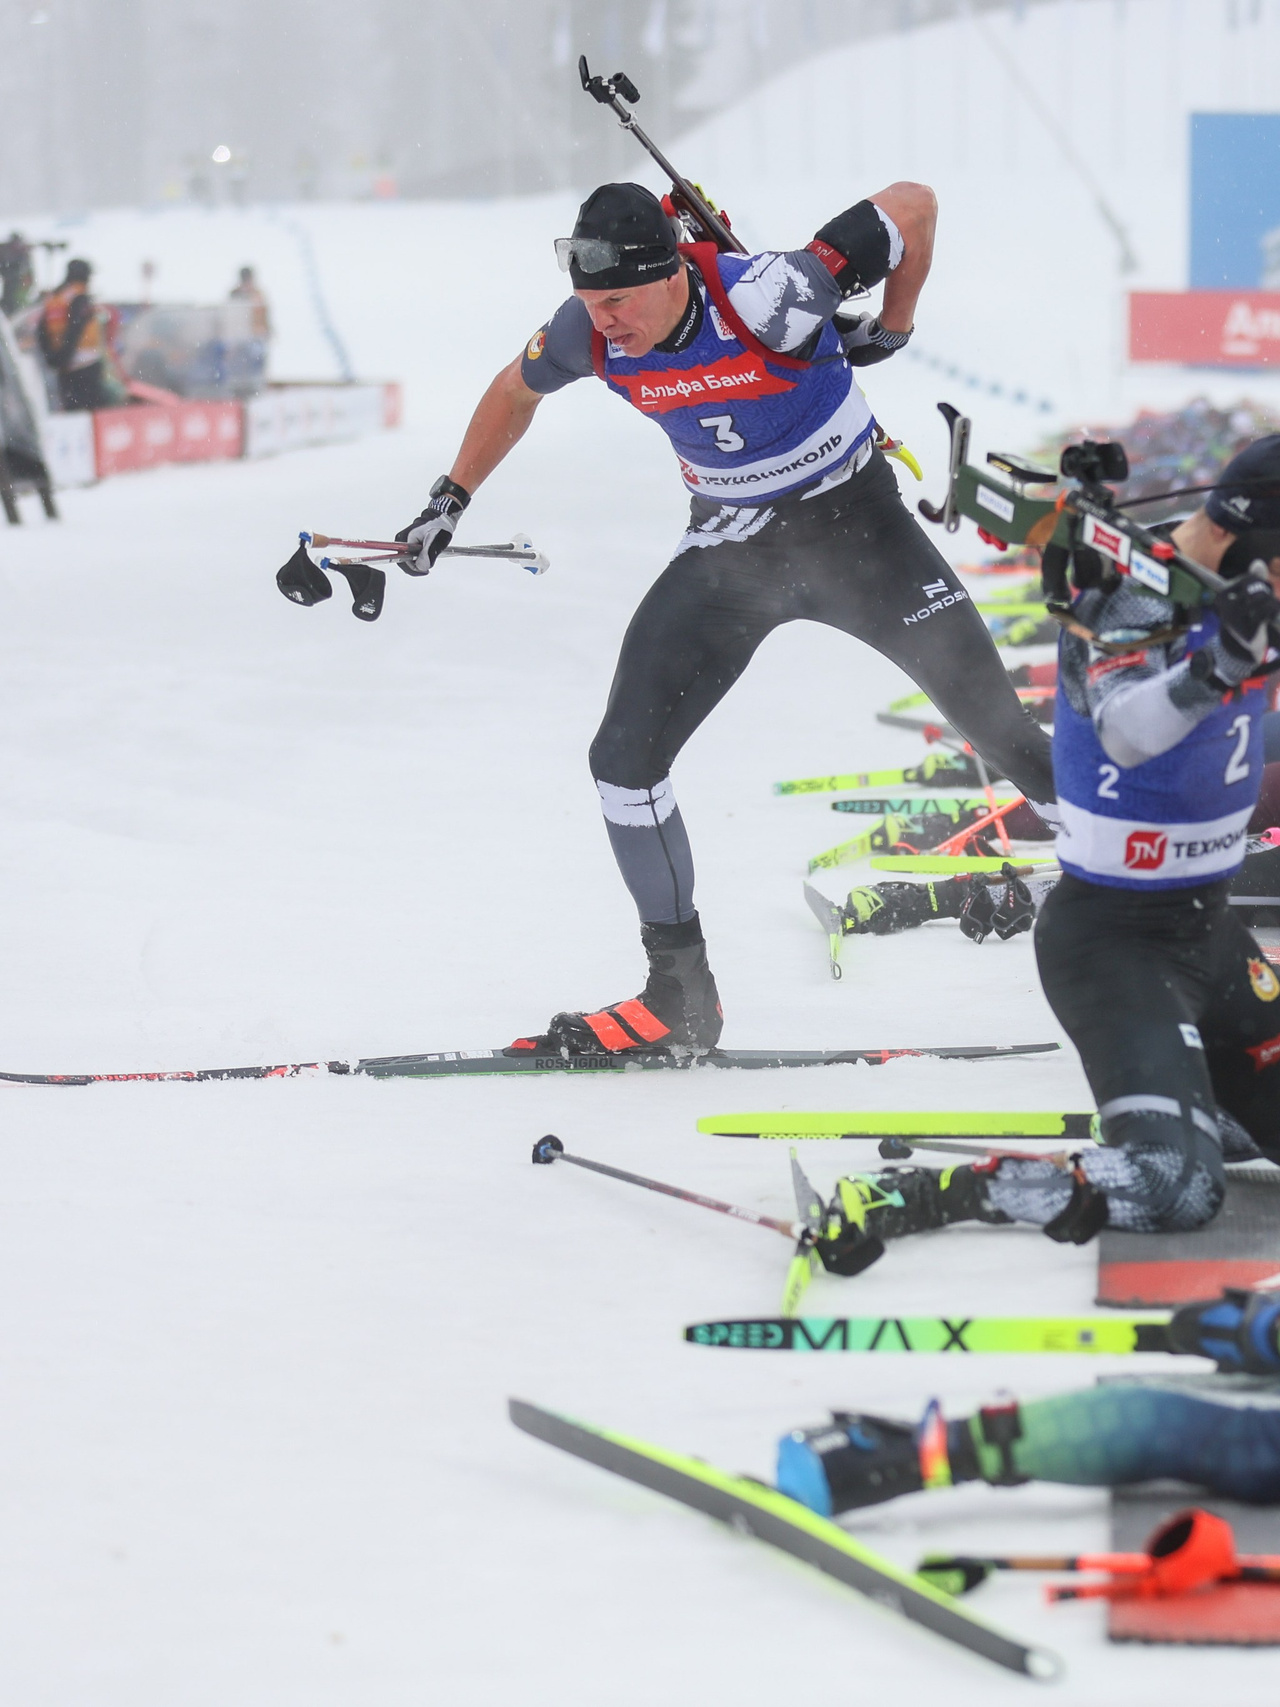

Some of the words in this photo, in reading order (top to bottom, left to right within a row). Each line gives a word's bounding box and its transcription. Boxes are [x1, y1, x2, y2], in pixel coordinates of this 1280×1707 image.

[640, 380, 703, 405] Альфа
[704, 370, 762, 391] Банк
[699, 414, 745, 453] 3
[1224, 714, 1251, 785] 2
[1097, 763, 1120, 800] 2
[535, 1057, 618, 1070] ROSSIGNOL
[693, 1325, 784, 1347] SPEED
